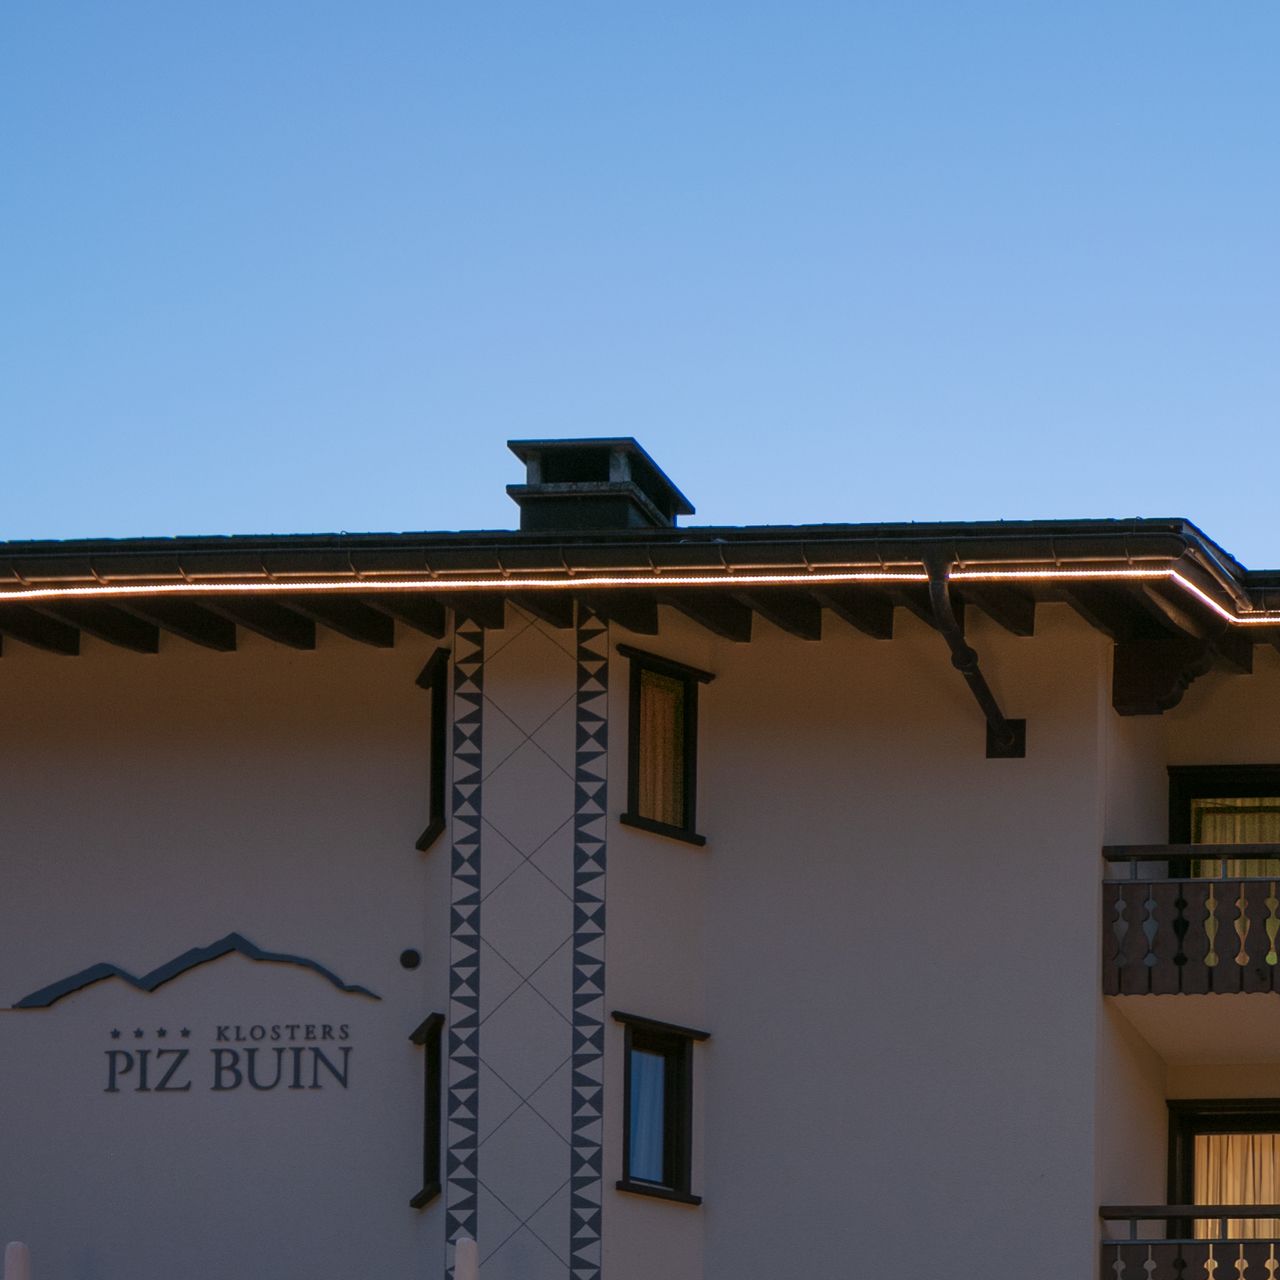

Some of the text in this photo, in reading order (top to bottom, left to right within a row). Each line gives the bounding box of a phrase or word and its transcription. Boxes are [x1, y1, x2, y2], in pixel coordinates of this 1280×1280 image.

[216, 1024, 350, 1041] KLOSTERS
[104, 1047, 353, 1093] PIZ BUIN
